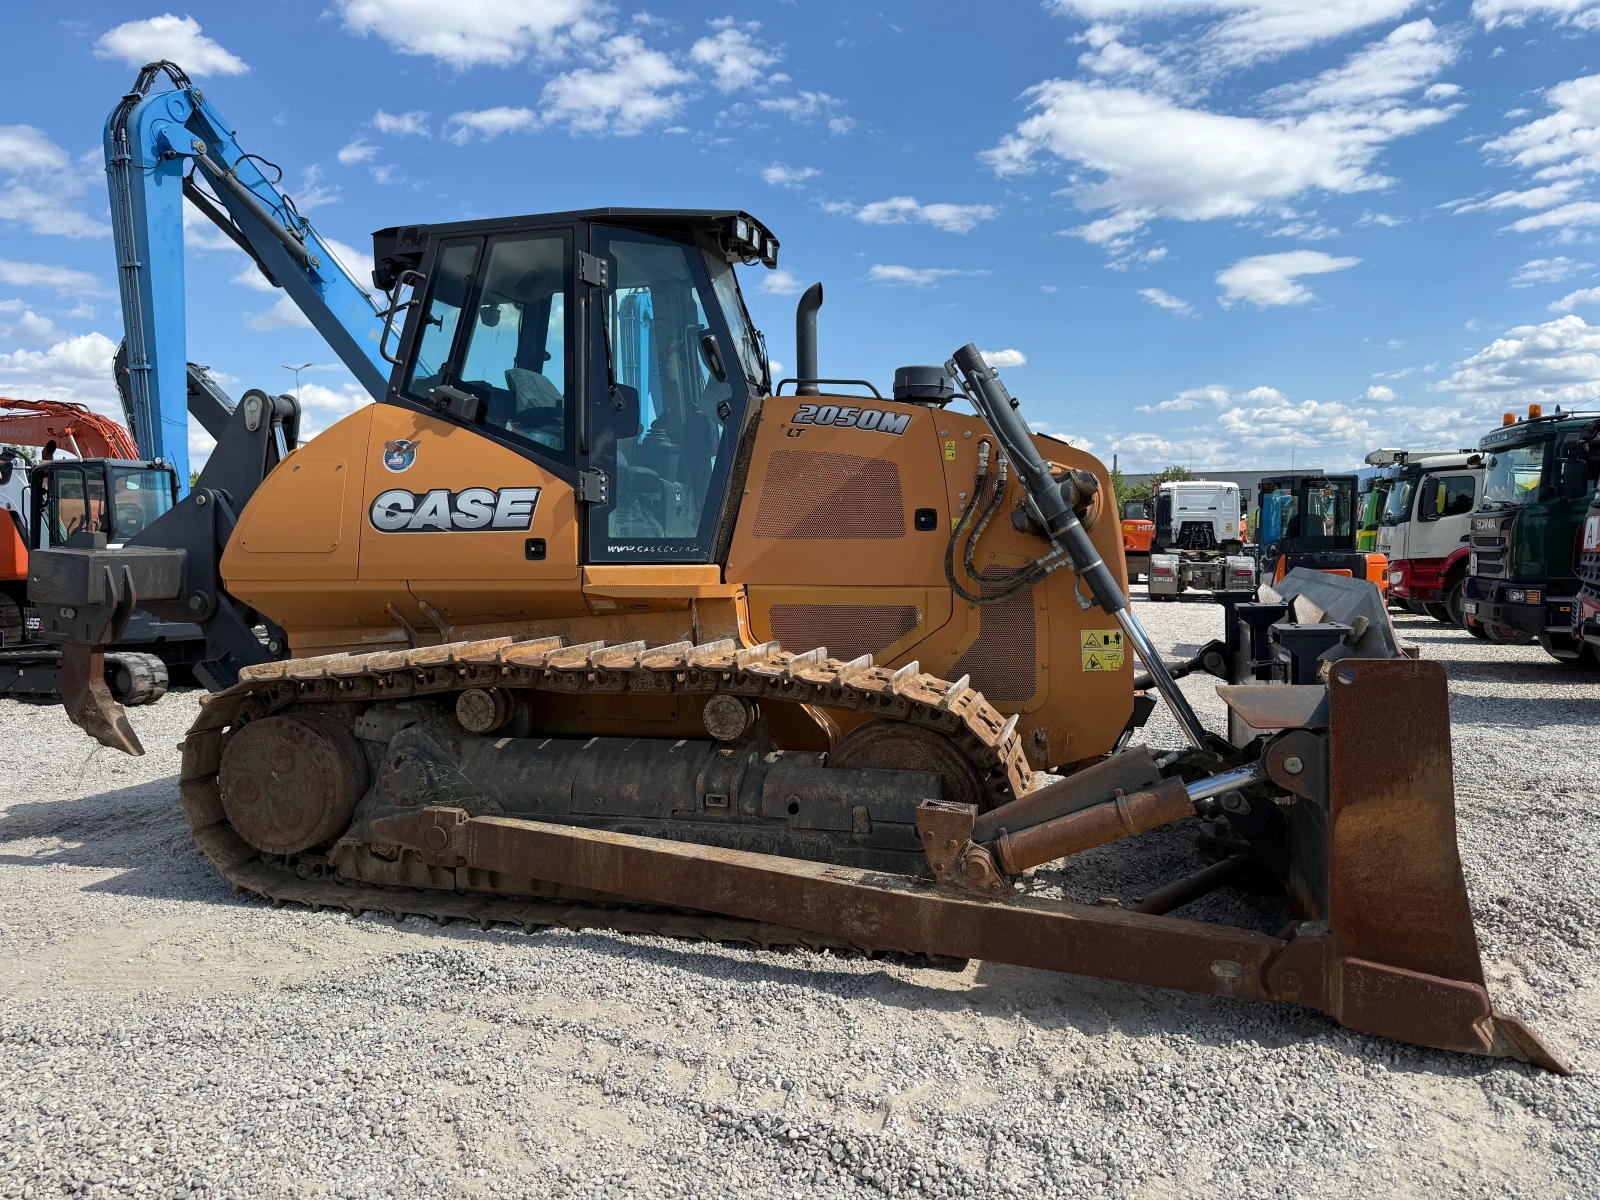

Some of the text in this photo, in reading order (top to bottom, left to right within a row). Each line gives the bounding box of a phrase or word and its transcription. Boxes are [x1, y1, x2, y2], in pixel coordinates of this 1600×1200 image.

[791, 403, 912, 435] 2050M
[0, 426, 32, 436] ITACHI
[787, 428, 805, 438] LT
[370, 487, 541, 531] CASE
[1476, 518, 1496, 530] SCANIA
[1586, 523, 1593, 544] A
